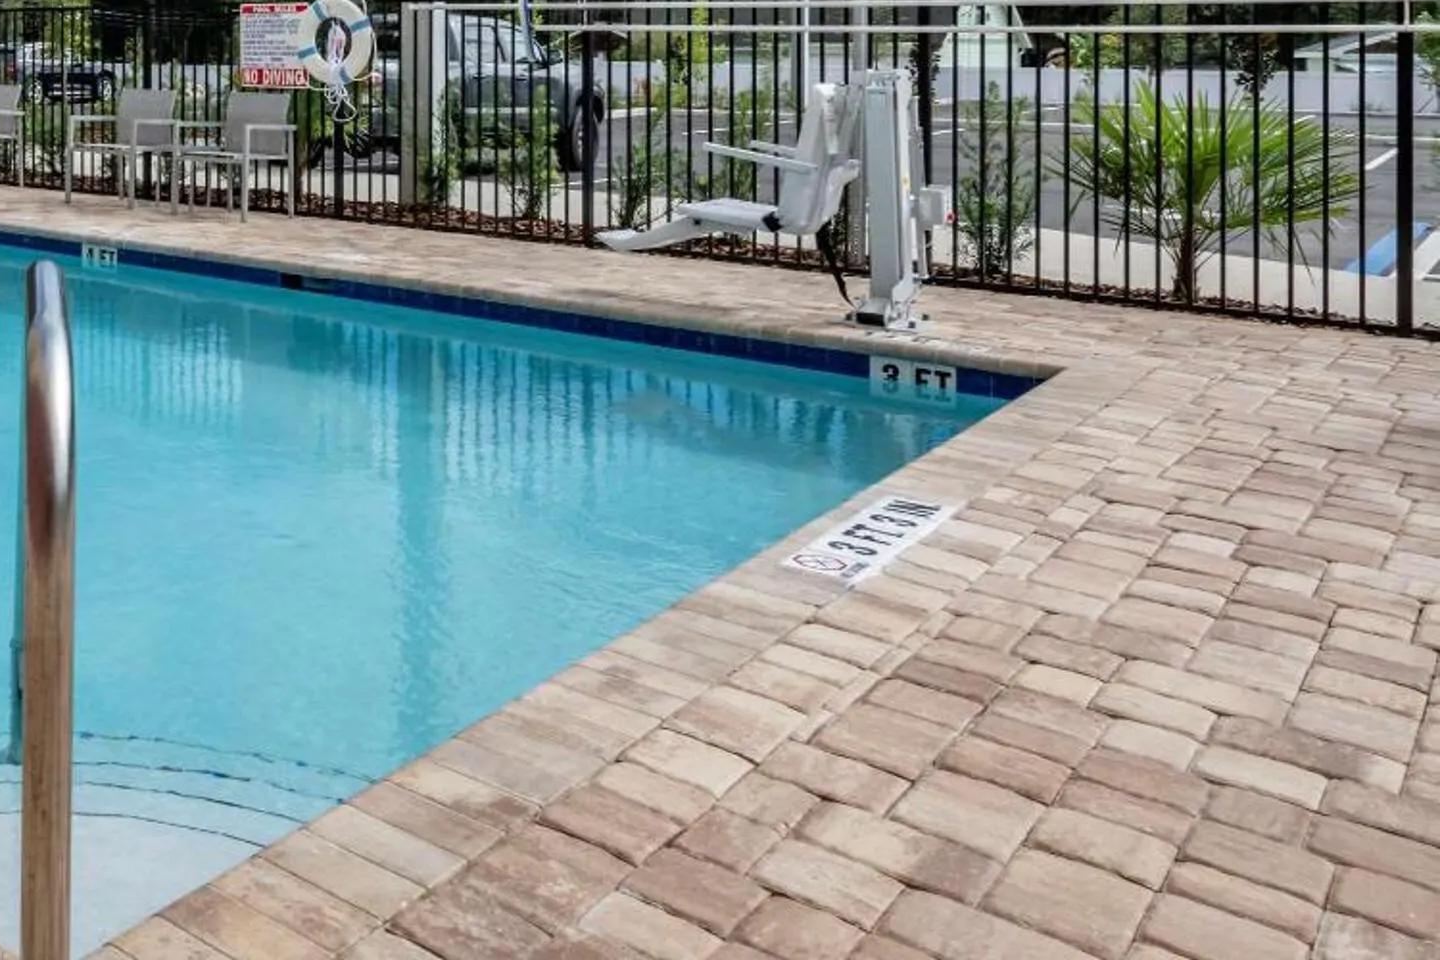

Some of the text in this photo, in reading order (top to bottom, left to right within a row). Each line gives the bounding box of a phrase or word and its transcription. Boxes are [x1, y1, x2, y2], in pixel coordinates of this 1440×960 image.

[244, 67, 259, 84] NO
[914, 367, 952, 390] FT
[827, 540, 879, 556] 3
[869, 513, 918, 527] 3
